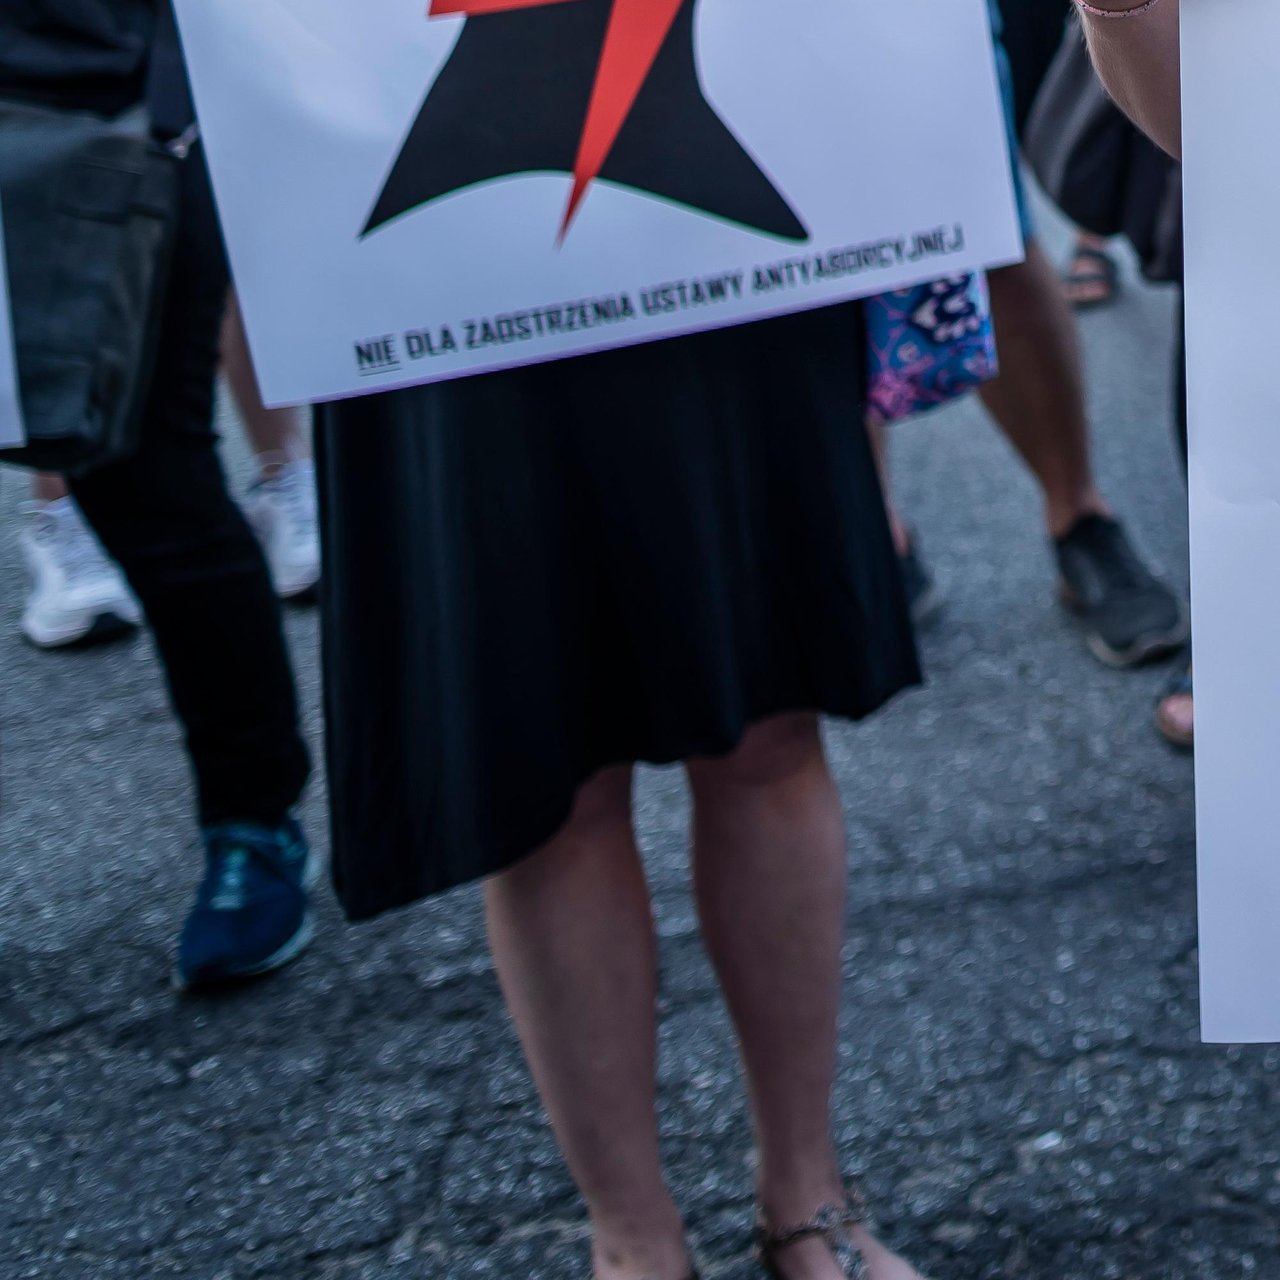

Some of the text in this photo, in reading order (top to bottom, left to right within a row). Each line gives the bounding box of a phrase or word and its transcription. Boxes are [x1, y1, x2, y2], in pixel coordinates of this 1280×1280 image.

[355, 334, 400, 370] NIE
[404, 323, 457, 361] DLA
[465, 290, 636, 351] ZAOSTRZENIA
[640, 271, 744, 317] USTAWY
